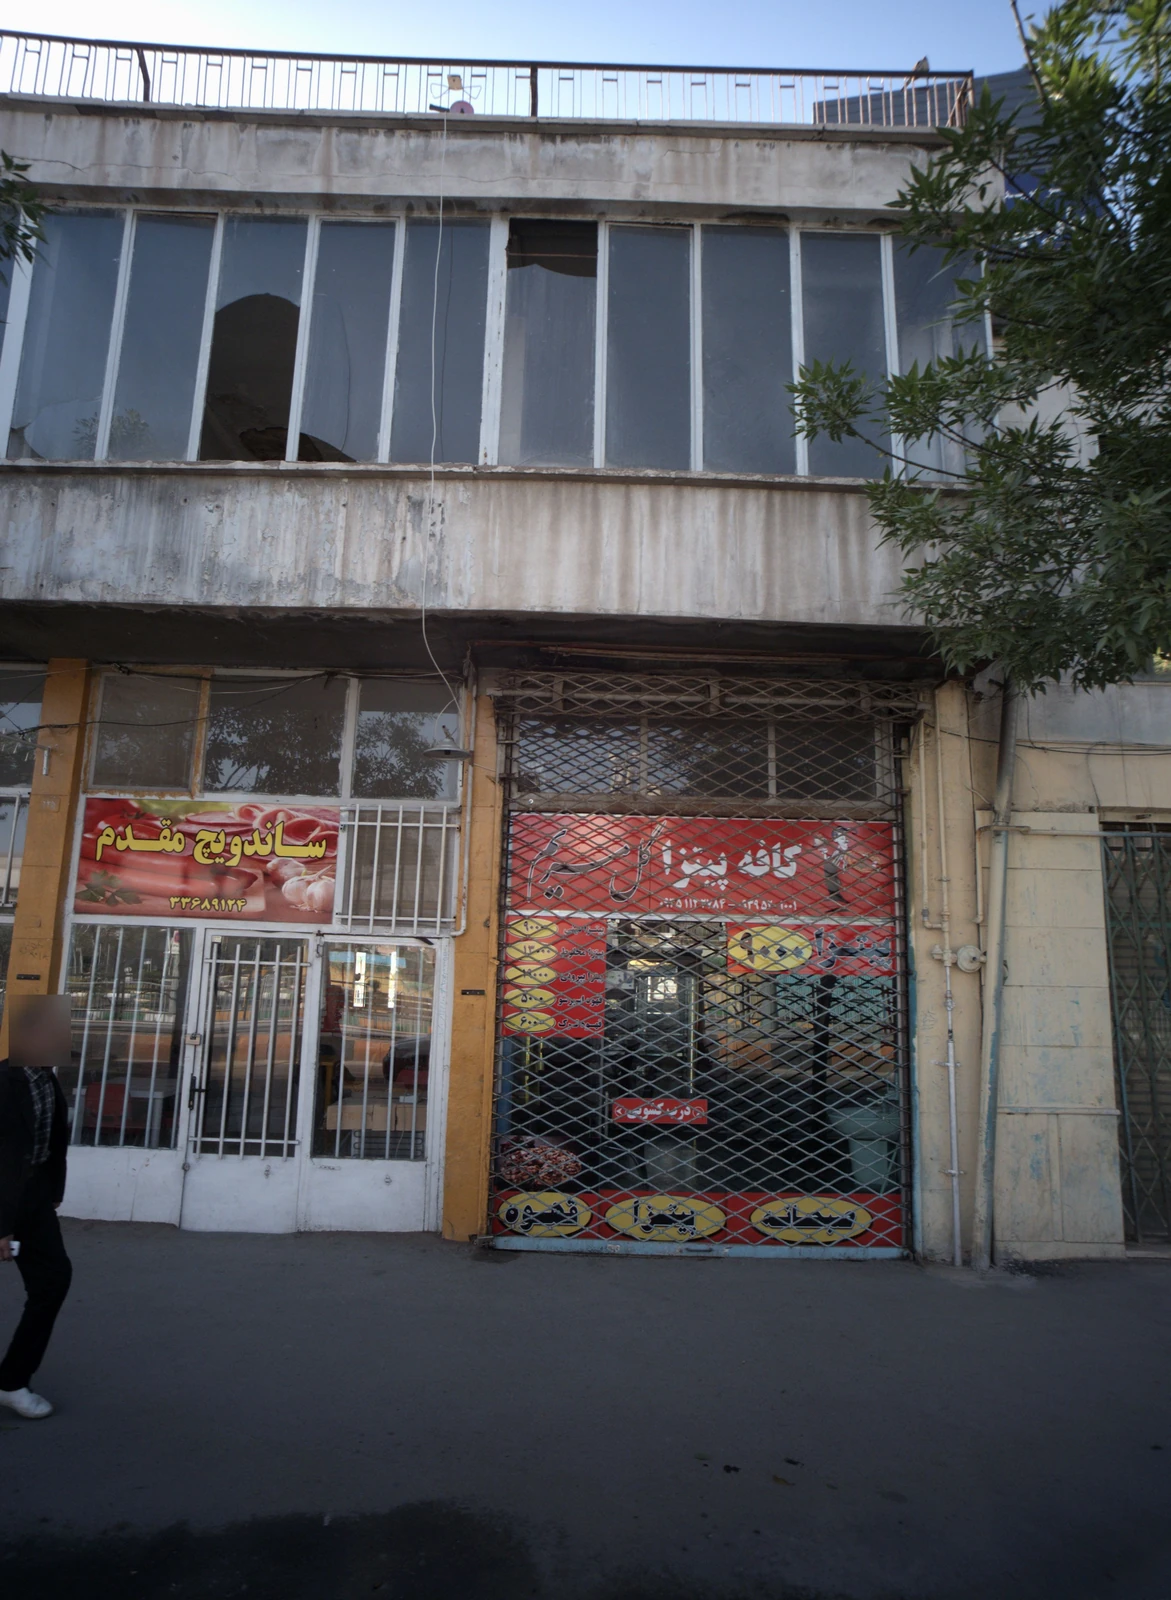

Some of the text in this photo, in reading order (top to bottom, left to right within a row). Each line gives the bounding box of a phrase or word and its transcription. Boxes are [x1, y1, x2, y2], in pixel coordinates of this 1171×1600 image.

[95, 818, 327, 867] ساندویچ مقدم
[737, 839, 802, 878] کافه
[661, 839, 729, 891] پیتزا
[169, 896, 247, 912] ۳۳۶۸۹۱۲۴
[740, 927, 893, 970] پیتزا ۹۰۰۰
[520, 1016, 545, 1027] ۶۰۰
[504, 1198, 856, 1237] صبحانه پیتزا قهوه
